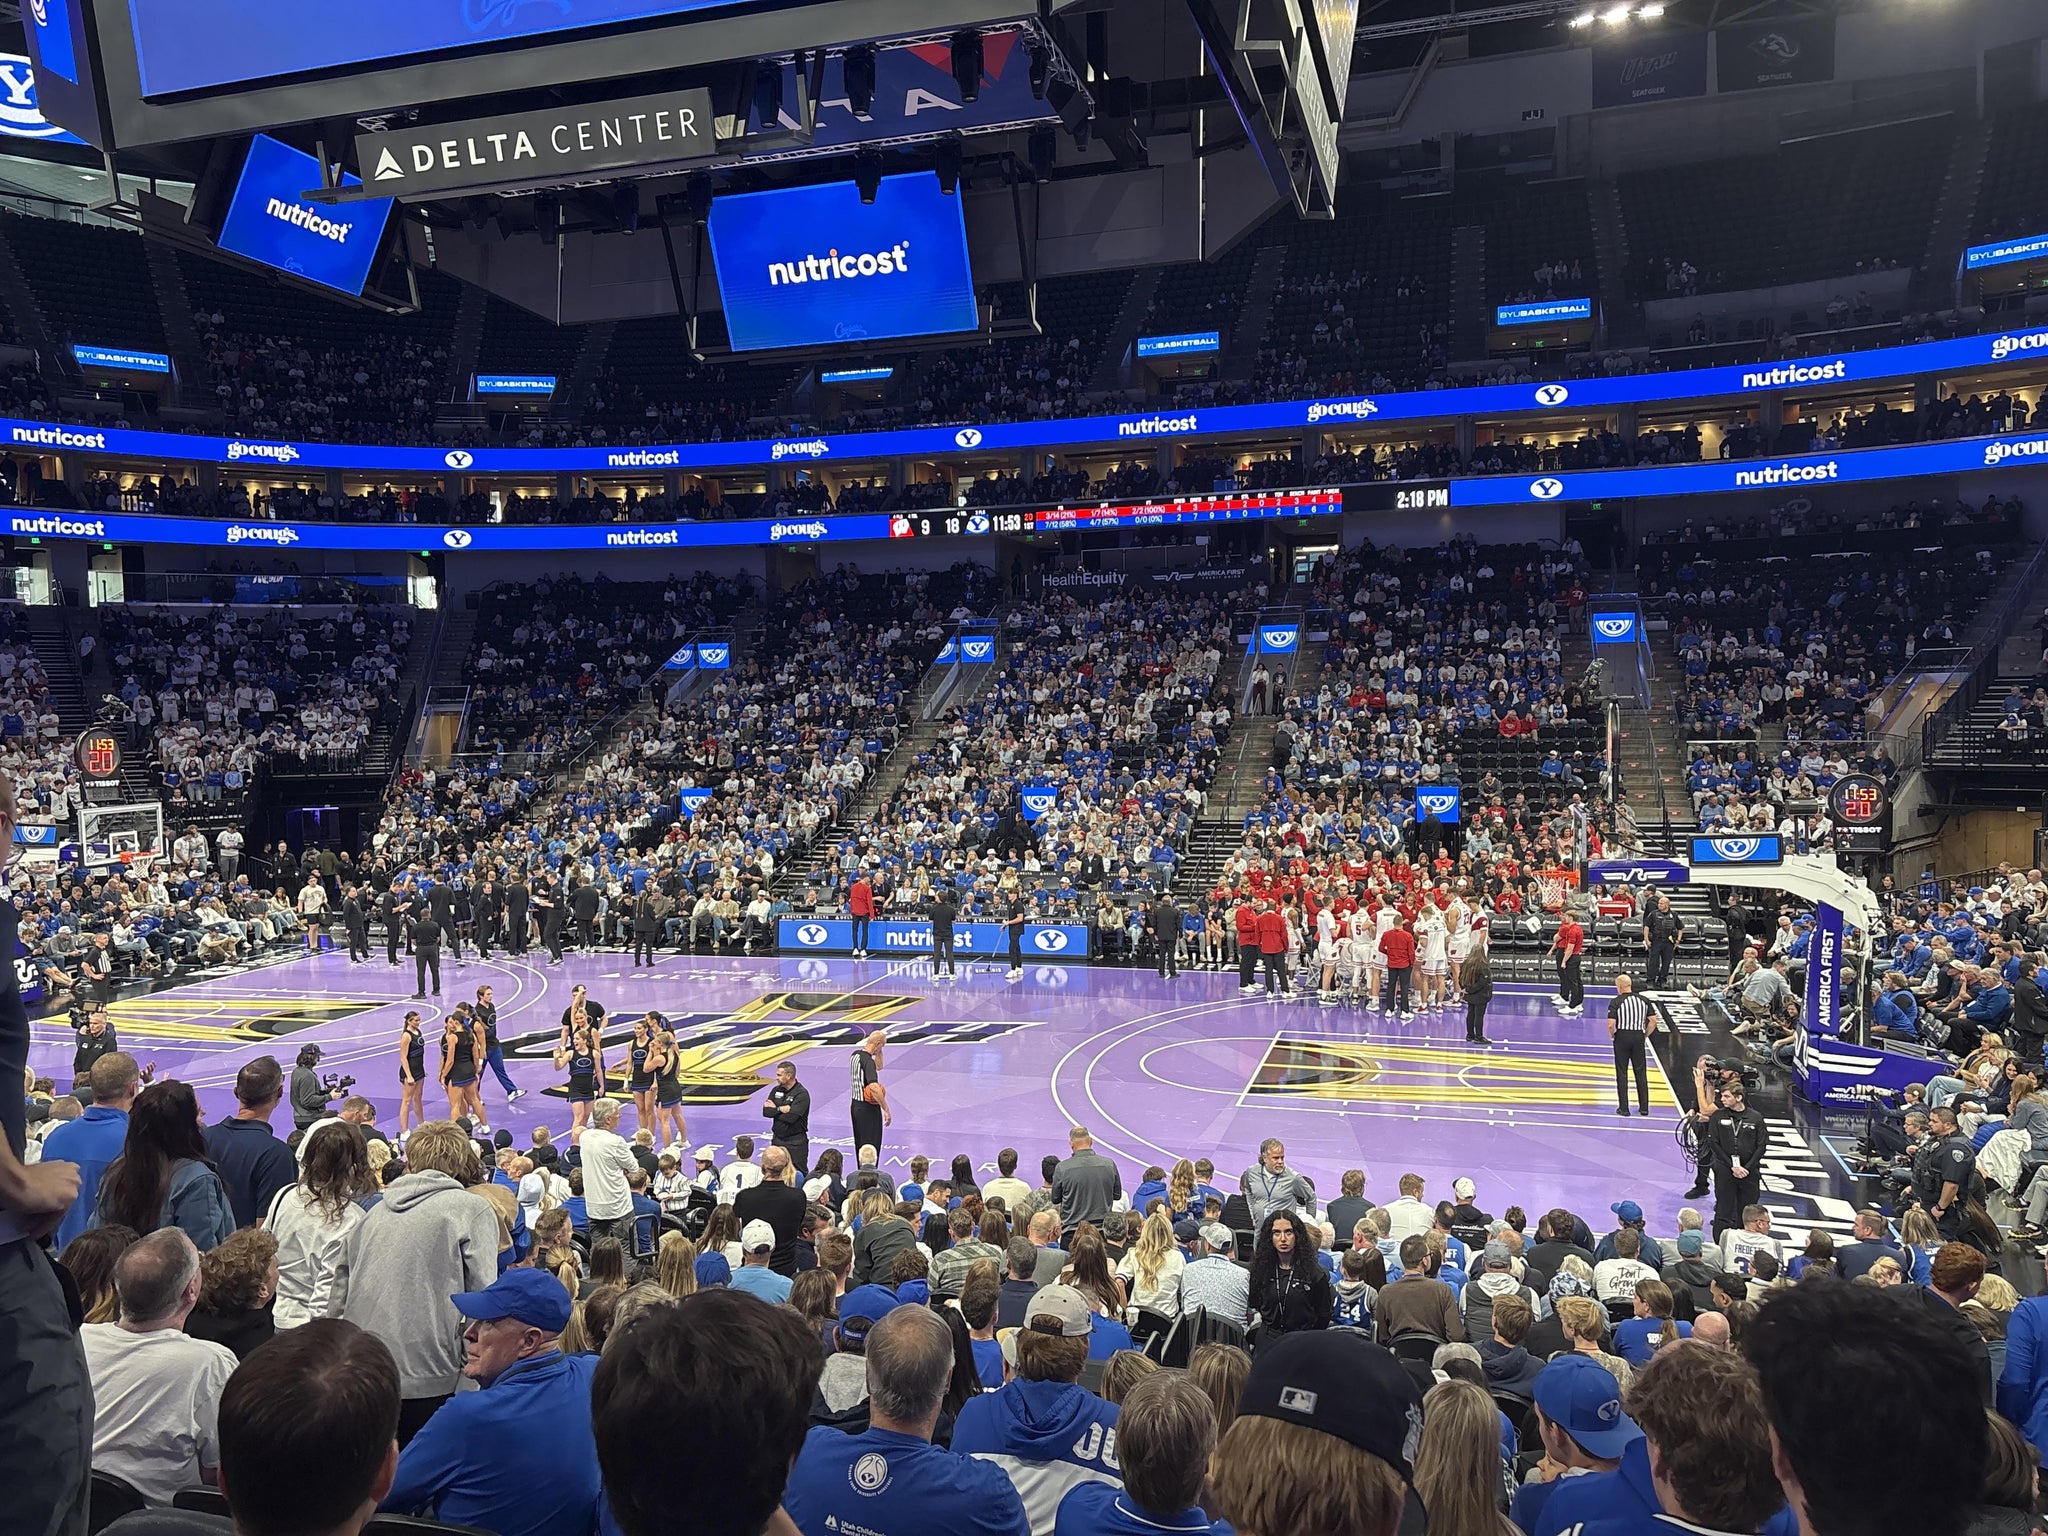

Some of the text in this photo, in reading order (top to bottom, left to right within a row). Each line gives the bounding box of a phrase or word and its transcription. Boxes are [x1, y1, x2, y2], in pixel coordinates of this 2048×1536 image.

[0, 65, 35, 104] Y
[1758, 72, 1792, 82] SEATGEEK
[1632, 87, 1665, 97] SEATGEEK
[412, 109, 698, 173] DELTA CENTER
[267, 198, 353, 243] nutricost
[769, 240, 909, 285] nutricost
[1743, 360, 1845, 388] nutricost
[1542, 388, 1562, 402] Y
[1119, 415, 1197, 435] nutricost
[12, 427, 105, 449] nutricost
[960, 431, 979, 446] Y
[450, 453, 469, 466] Y
[608, 450, 679, 466] nutricost
[1736, 461, 1838, 486] nutricost
[1538, 481, 1558, 495] Y
[1397, 488, 1448, 509] 2:18 PM
[993, 514, 1021, 531] 11:53
[1024, 513, 1033, 521] 20
[1024, 521, 1034, 529] 1ST
[12, 516, 105, 539] nutricost
[921, 519, 930, 535] 9
[945, 518, 960, 534] 18
[449, 532, 468, 546] Y
[607, 529, 678, 545] nutricost
[1042, 572, 1126, 588] HealthEquity
[89, 738, 114, 750] 11:53
[89, 751, 113, 772] 20
[1846, 801, 1871, 817] 20
[806, 927, 821, 942] Y
[1355, 924, 1362, 935] 5
[886, 928, 972, 948] nutrist
[1044, 931, 1061, 948] Y
[19, 980, 39, 990] FIRST
[629, 972, 719, 982] DELTA
[729, 976, 834, 985] CENTER
[1818, 928, 1835, 1027] AMERICA FIRST
[1856, 1093, 1872, 1101] FIRS
[735, 1174, 743, 1189] 1
[1339, 1302, 1361, 1322] 24
[1601, 1402, 1618, 1419] Y
[841, 1520, 856, 1532] Utah
